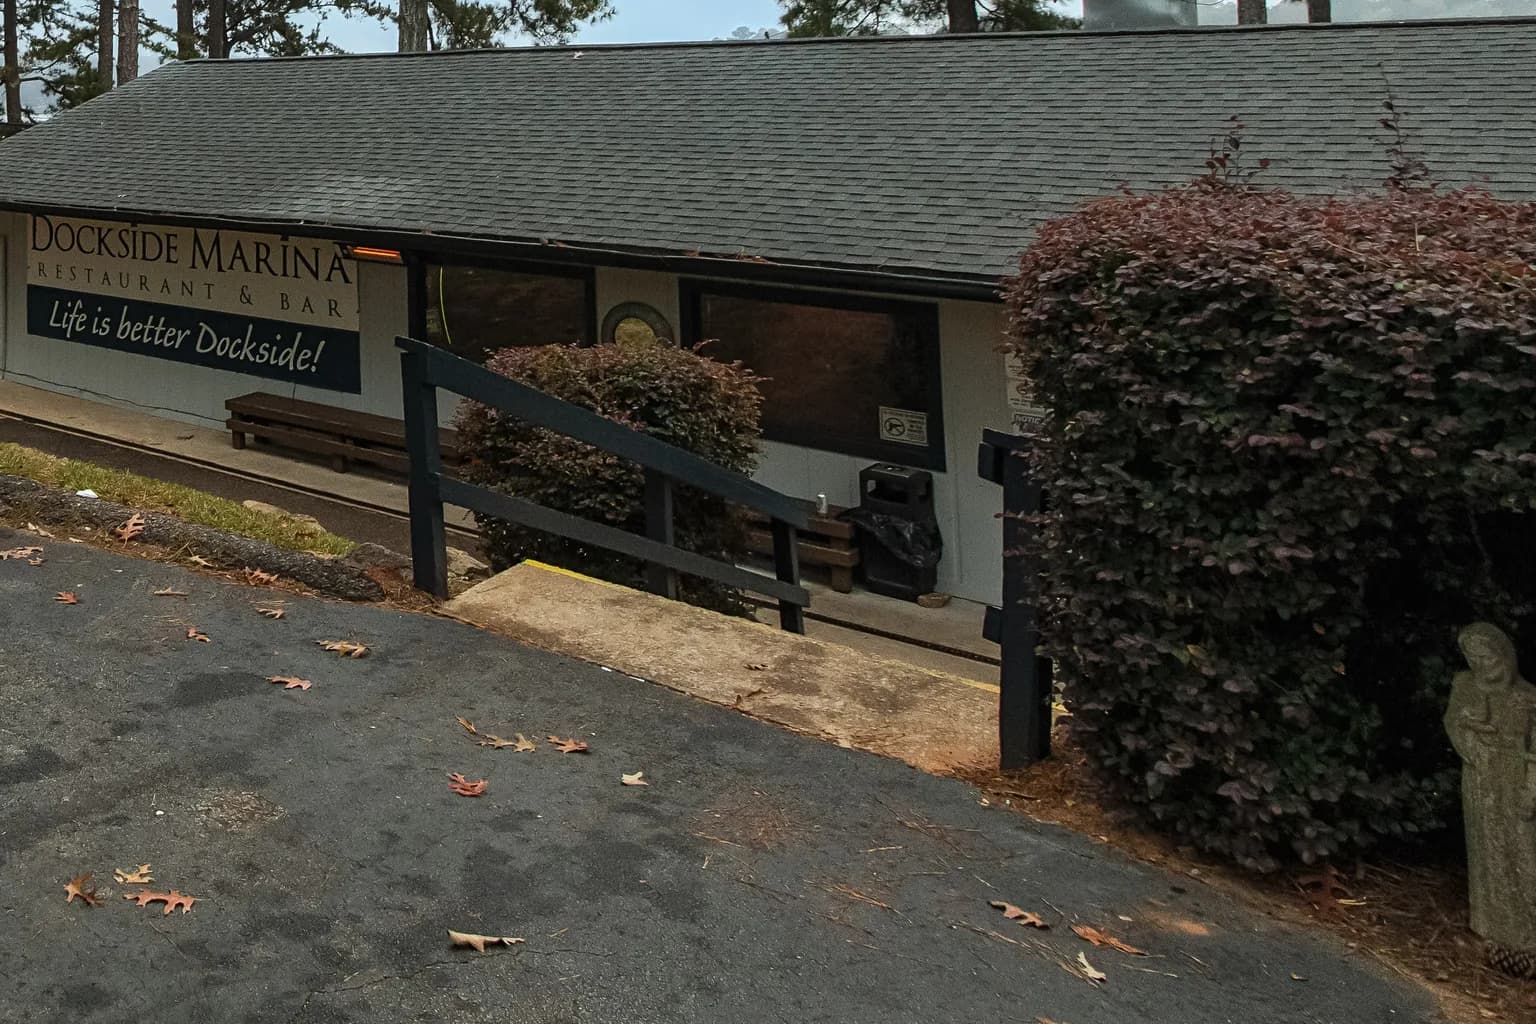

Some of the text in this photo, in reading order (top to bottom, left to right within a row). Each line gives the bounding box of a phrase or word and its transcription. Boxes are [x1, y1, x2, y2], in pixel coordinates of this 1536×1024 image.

[32, 215, 352, 284] DOCKSIDE MARINA
[38, 262, 343, 318] RESTAURANT & BAR
[49, 300, 325, 372] Life is better Dockside!
